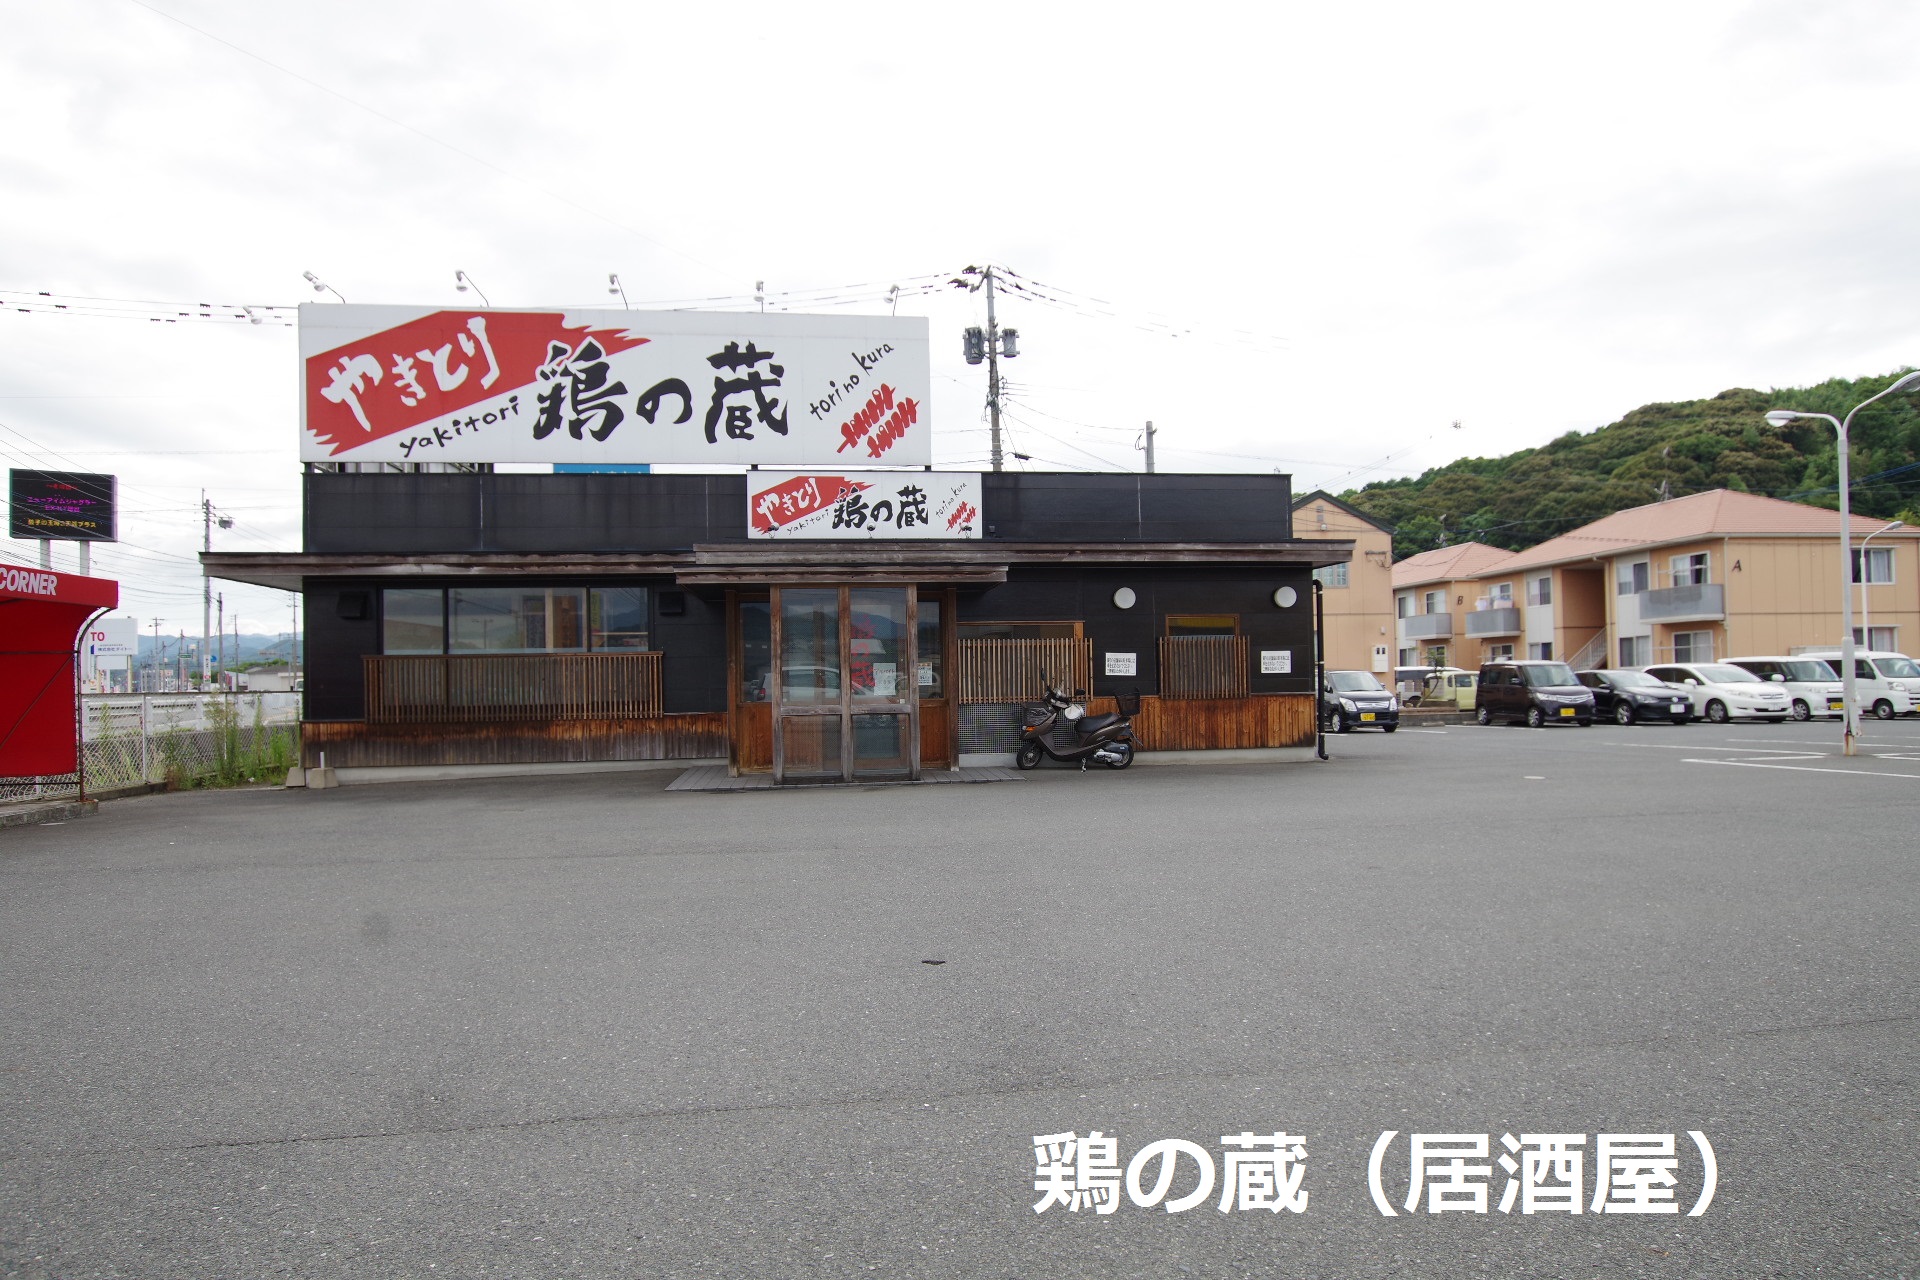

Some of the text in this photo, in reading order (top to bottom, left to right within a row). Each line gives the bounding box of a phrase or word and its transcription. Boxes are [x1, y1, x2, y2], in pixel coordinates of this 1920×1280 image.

[321, 316, 500, 432] やきとり
[533, 338, 788, 443] 鶏の蔵
[810, 343, 894, 421] tori no kura
[400, 396, 519, 458] yakitori
[756, 477, 821, 526] やきとり
[786, 508, 829, 536] yakitori
[832, 483, 929, 529] 鶏の蔵
[0, 567, 57, 596] CORNER
[1731, 560, 1742, 573] A
[1456, 595, 1464, 606] B
